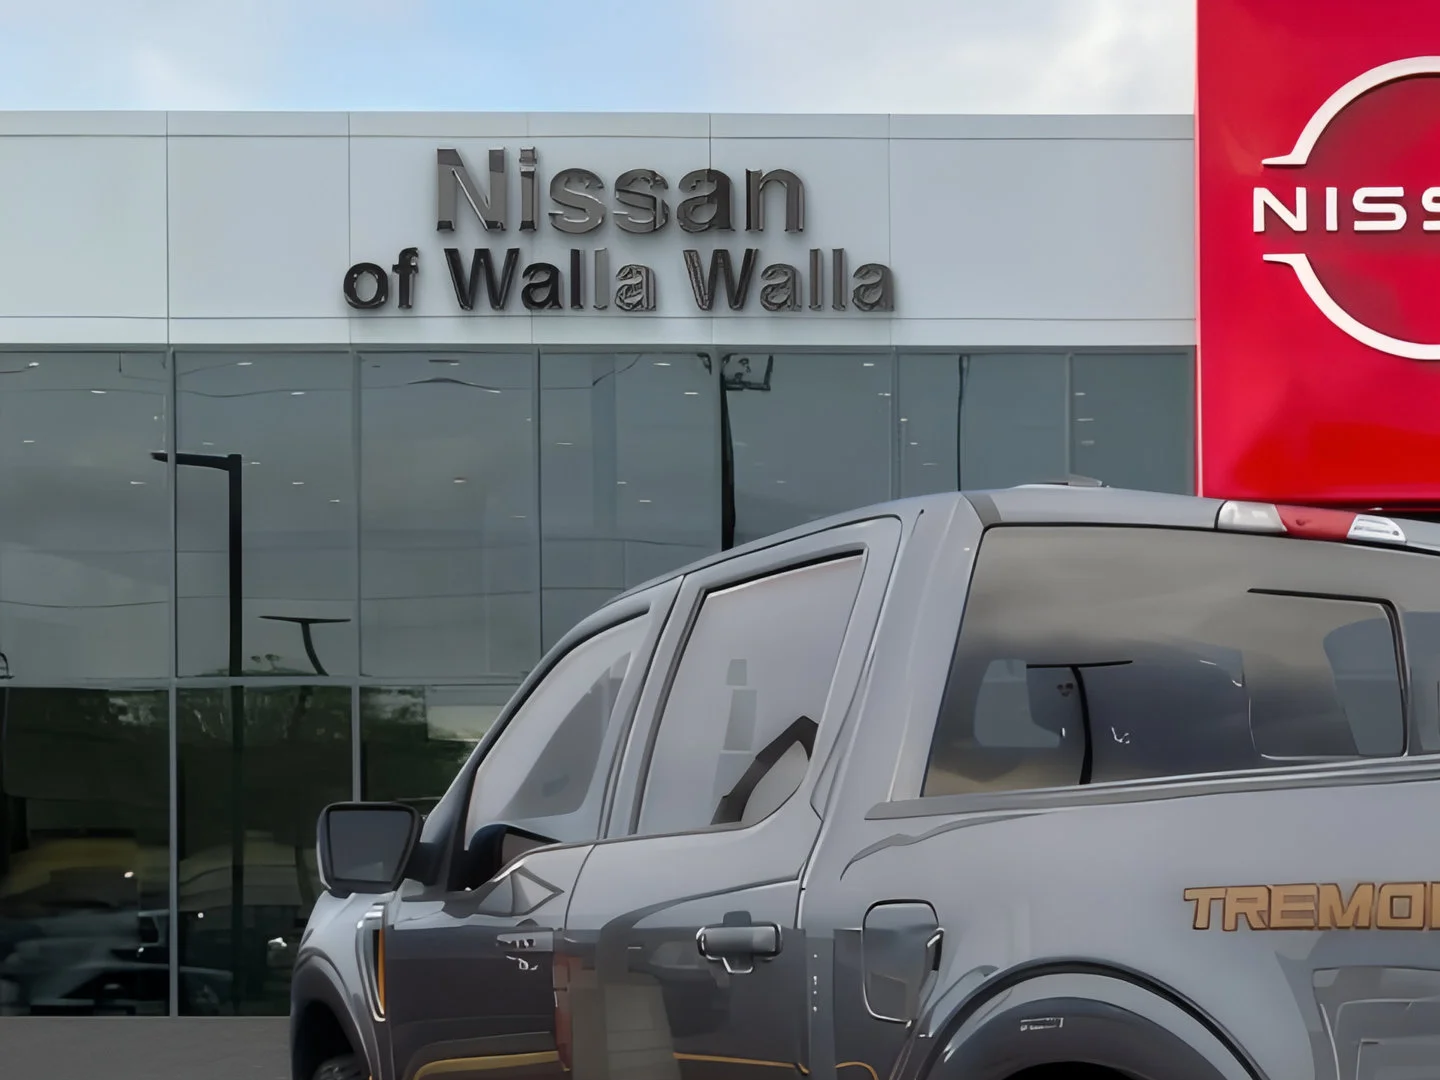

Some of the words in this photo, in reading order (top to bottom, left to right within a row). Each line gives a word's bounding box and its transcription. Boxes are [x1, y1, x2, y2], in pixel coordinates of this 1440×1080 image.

[436, 146, 806, 234] Nissan
[342, 246, 419, 310] of
[443, 246, 657, 313] Walla
[682, 246, 895, 313] Walla
